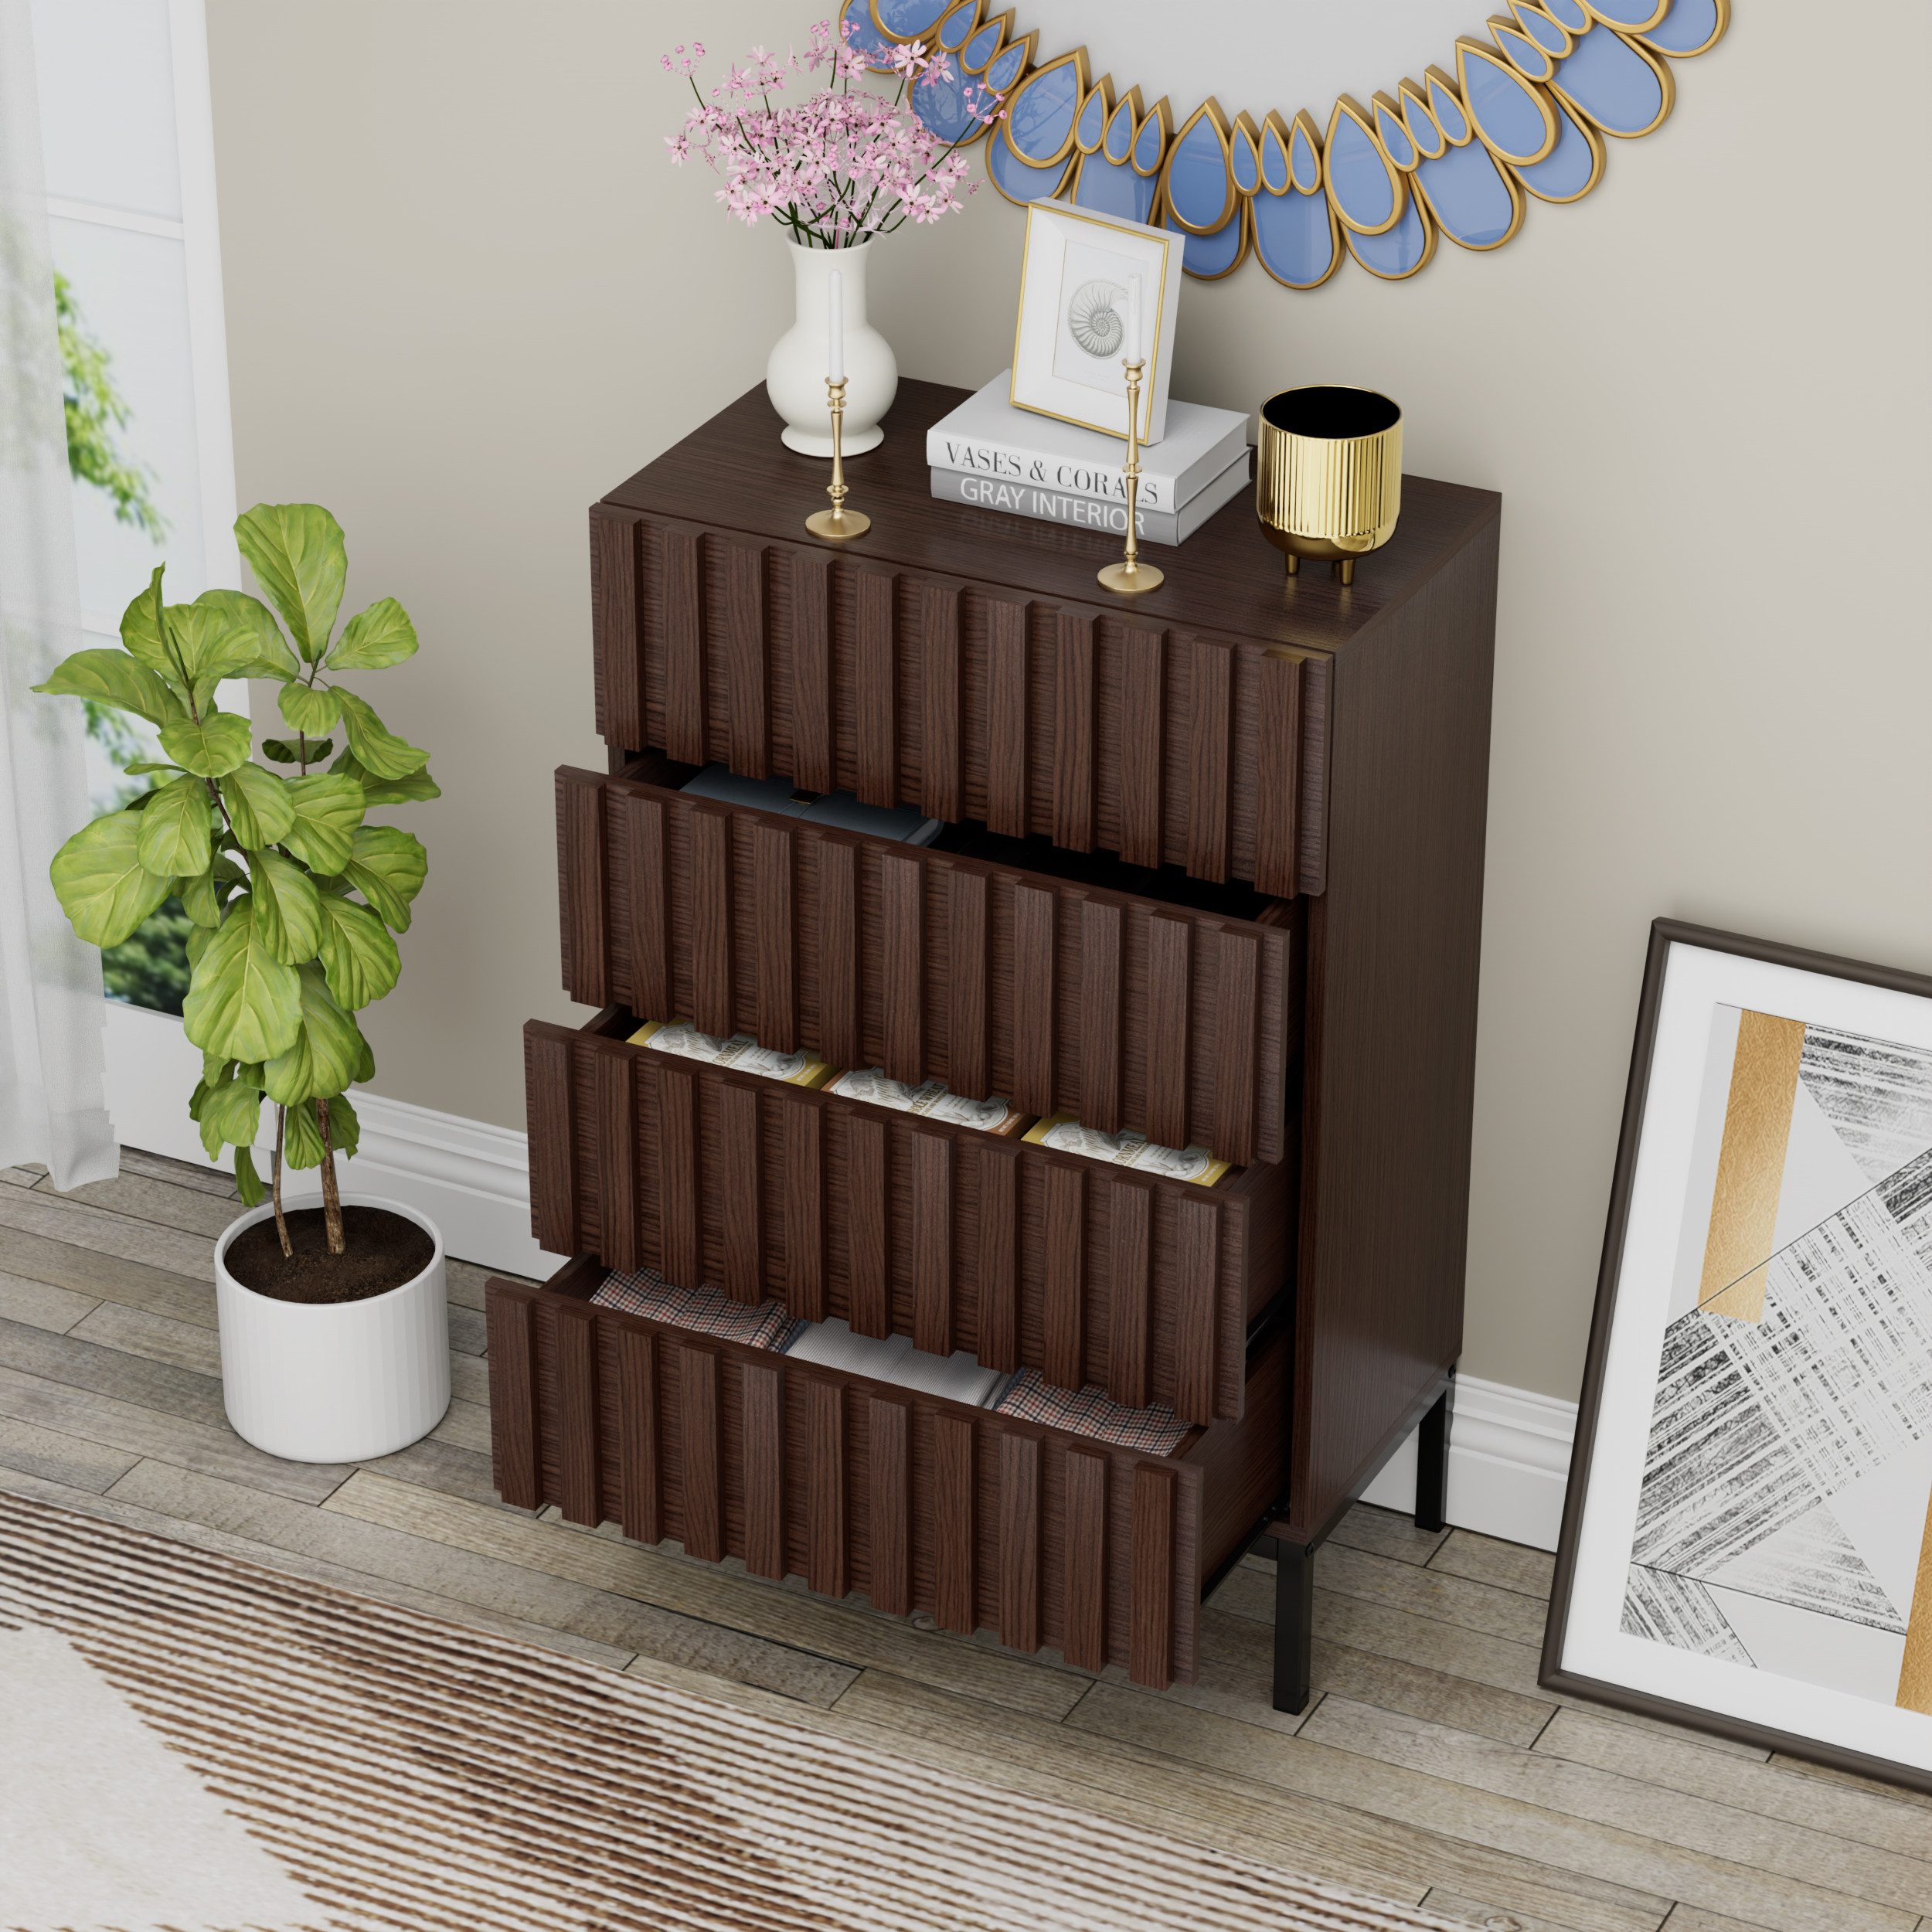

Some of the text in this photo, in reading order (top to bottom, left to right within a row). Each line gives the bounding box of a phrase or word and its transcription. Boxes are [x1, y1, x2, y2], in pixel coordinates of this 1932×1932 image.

[946, 441, 1158, 505] VASES & CORAS
[961, 478, 1145, 536] GRAY INTERIOR
[713, 1039, 748, 1064] ORNMEAL
[907, 1100, 928, 1114] HOLE
[919, 1083, 945, 1101] WHEAT
[1112, 1138, 1146, 1165] ORNMEAL
